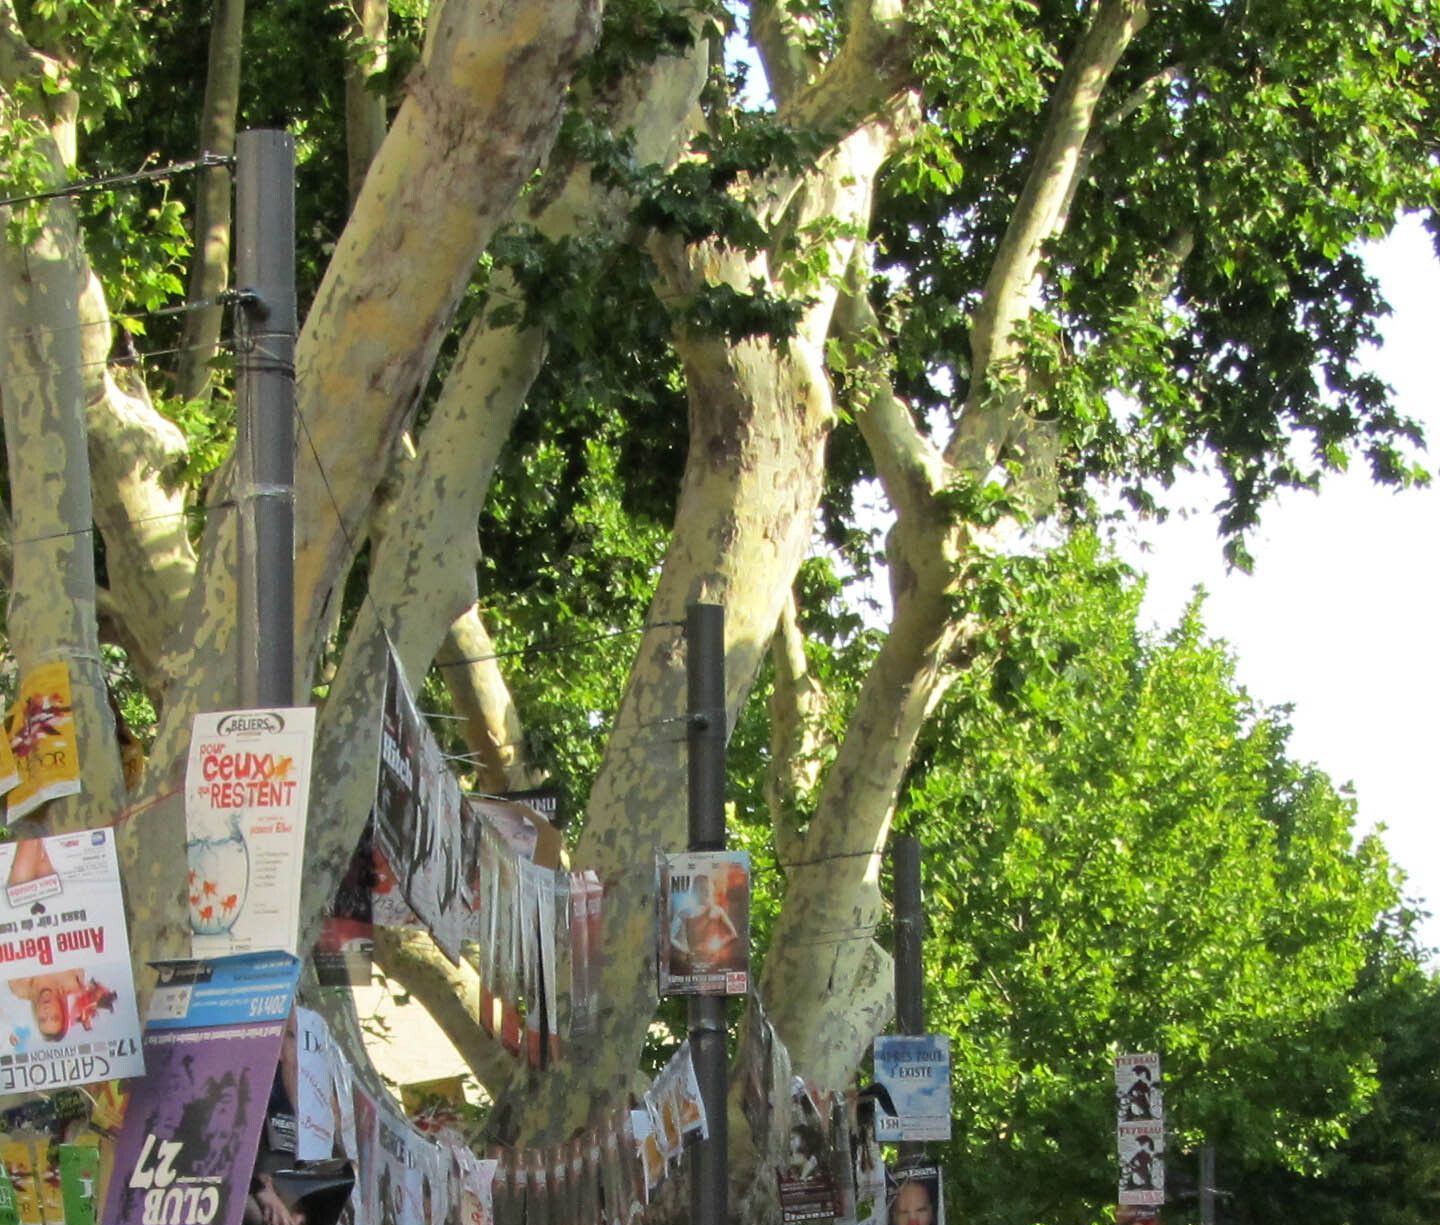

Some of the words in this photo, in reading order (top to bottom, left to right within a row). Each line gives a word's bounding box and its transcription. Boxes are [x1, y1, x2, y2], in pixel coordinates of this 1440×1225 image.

[202, 753, 274, 783] ceux
[211, 781, 297, 809] RESTENT
[57, 926, 105, 953] Anne
[1, 1055, 110, 1090] CAPITOLE
[129, 1134, 184, 1189] 27
[143, 1187, 221, 1225] CLUB
